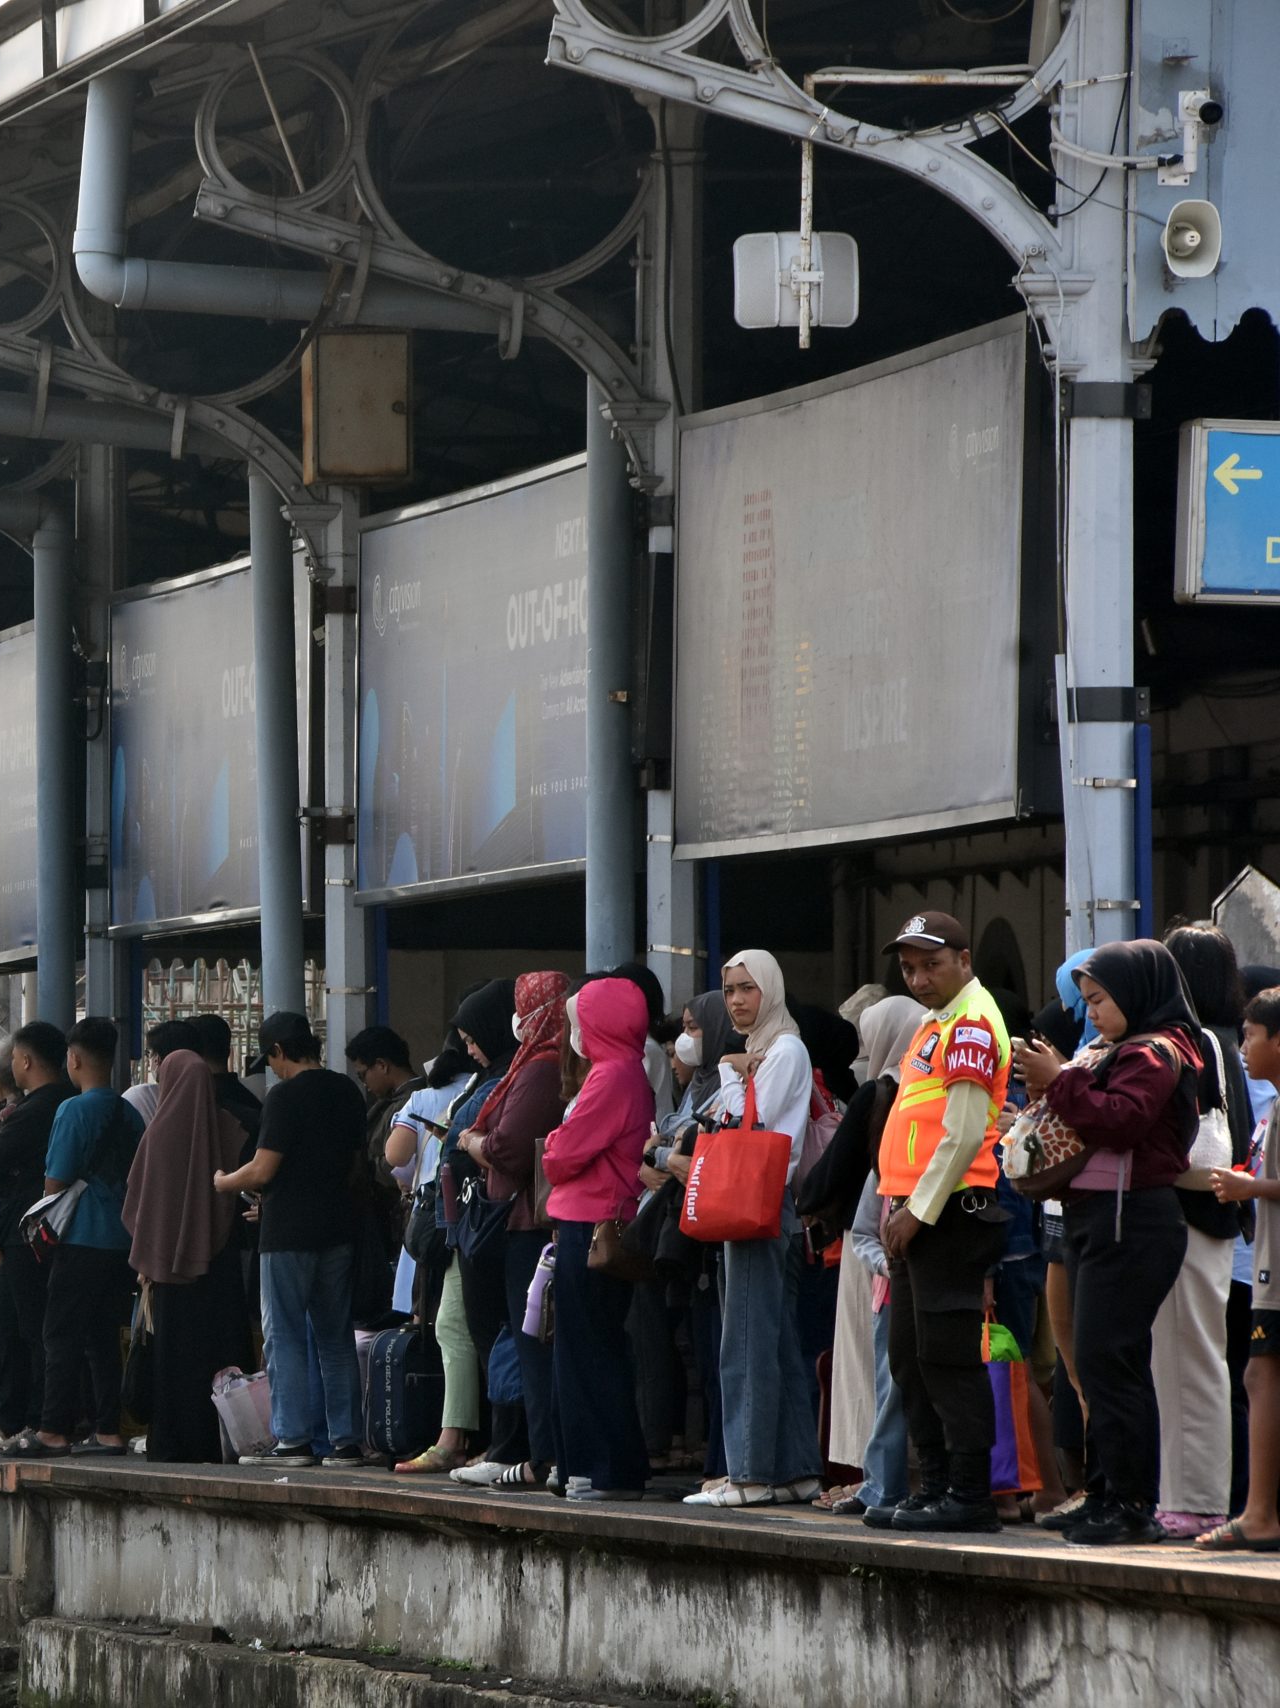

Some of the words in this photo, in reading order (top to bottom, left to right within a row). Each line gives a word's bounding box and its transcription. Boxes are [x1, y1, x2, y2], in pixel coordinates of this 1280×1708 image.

[555, 518, 581, 560] NEXT
[389, 580, 421, 622] cityvision
[132, 649, 156, 688] cityvision
[957, 1028, 973, 1037] KAI
[947, 1048, 994, 1078] WALKA
[690, 1156, 705, 1186] jiwa
[687, 1187, 698, 1222] janji
